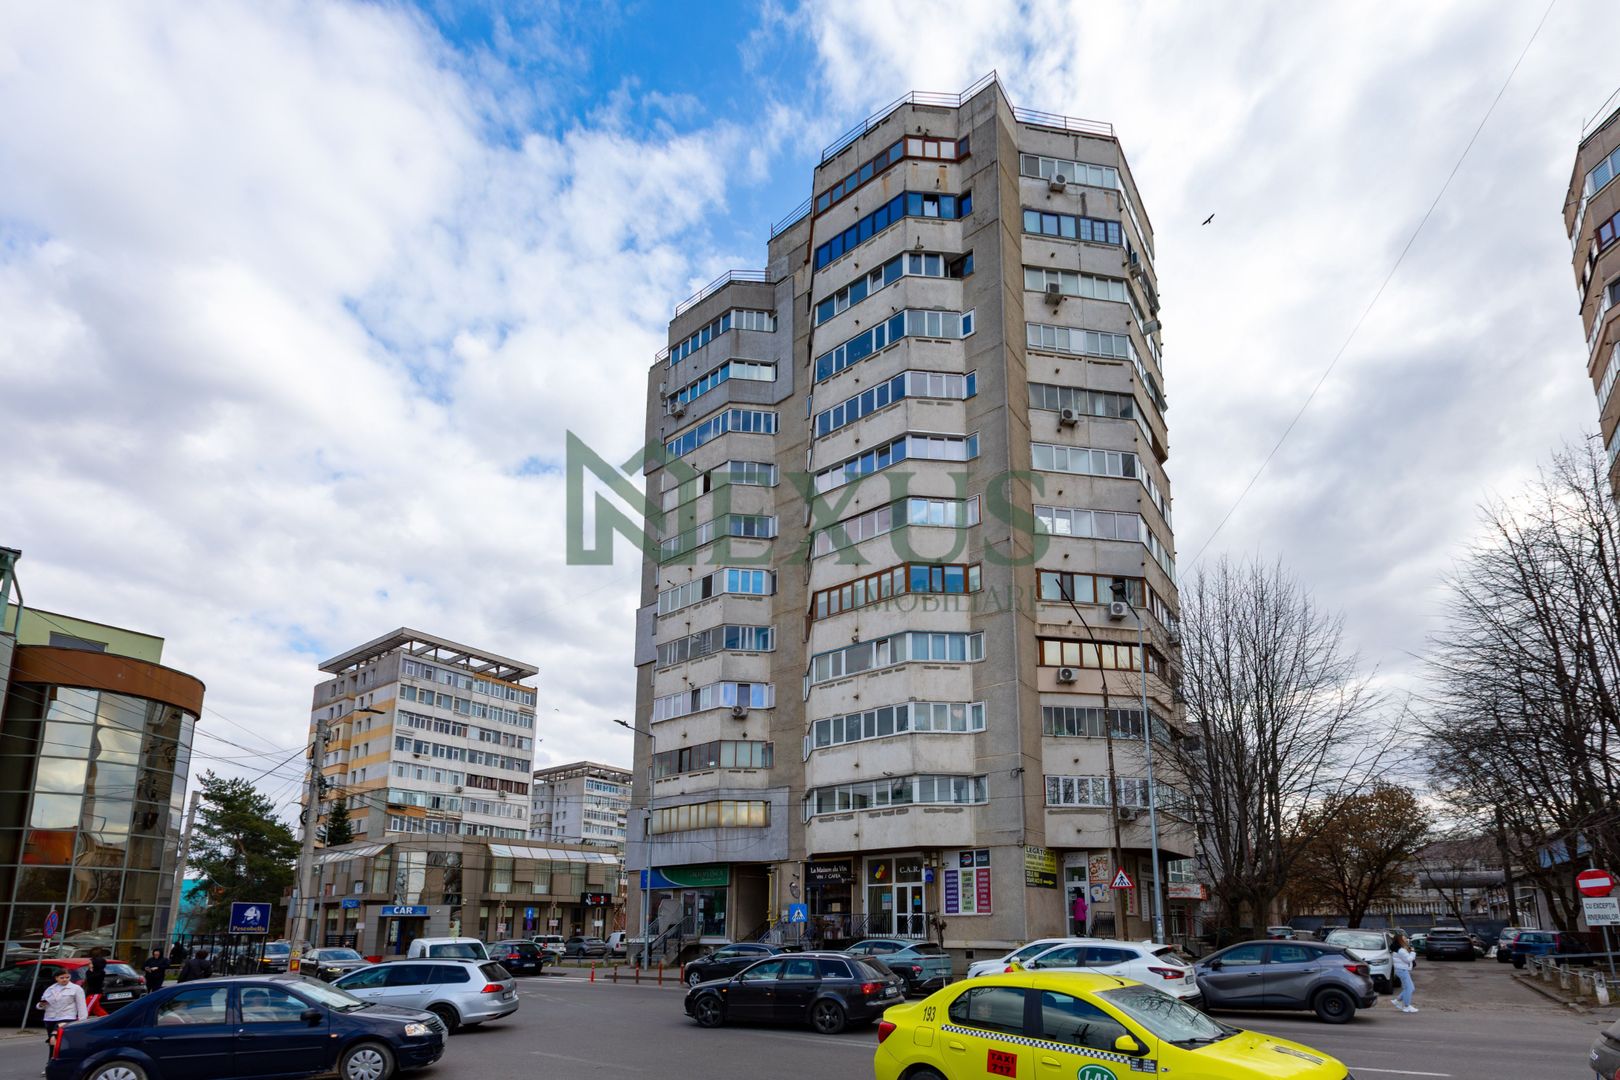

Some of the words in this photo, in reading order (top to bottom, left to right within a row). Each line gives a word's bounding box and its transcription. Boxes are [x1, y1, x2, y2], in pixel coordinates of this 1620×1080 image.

[393, 906, 413, 914] CAR
[922, 1006, 936, 1022] 193
[991, 1052, 1015, 1065] TAXI
[991, 1063, 1011, 1074] 717
